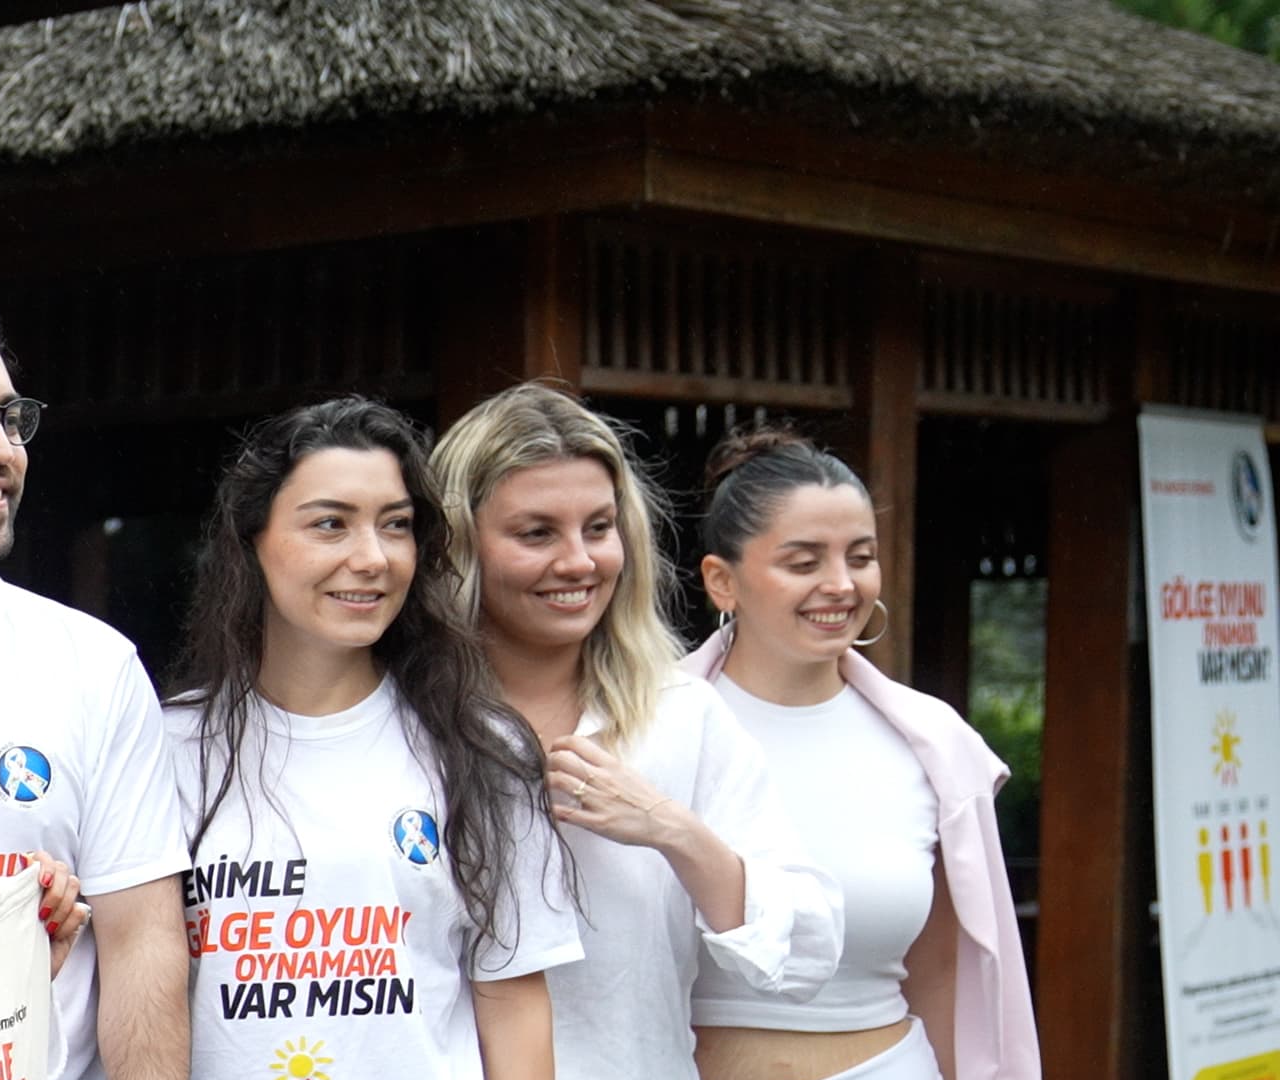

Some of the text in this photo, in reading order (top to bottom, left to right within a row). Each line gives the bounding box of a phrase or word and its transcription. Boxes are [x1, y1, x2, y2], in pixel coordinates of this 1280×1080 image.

[182, 854, 307, 908] ENİMLE
[185, 909, 275, 959] GÖLGE
[235, 948, 397, 982] OYNAMAYA
[220, 978, 416, 1020] VAR MISIN
